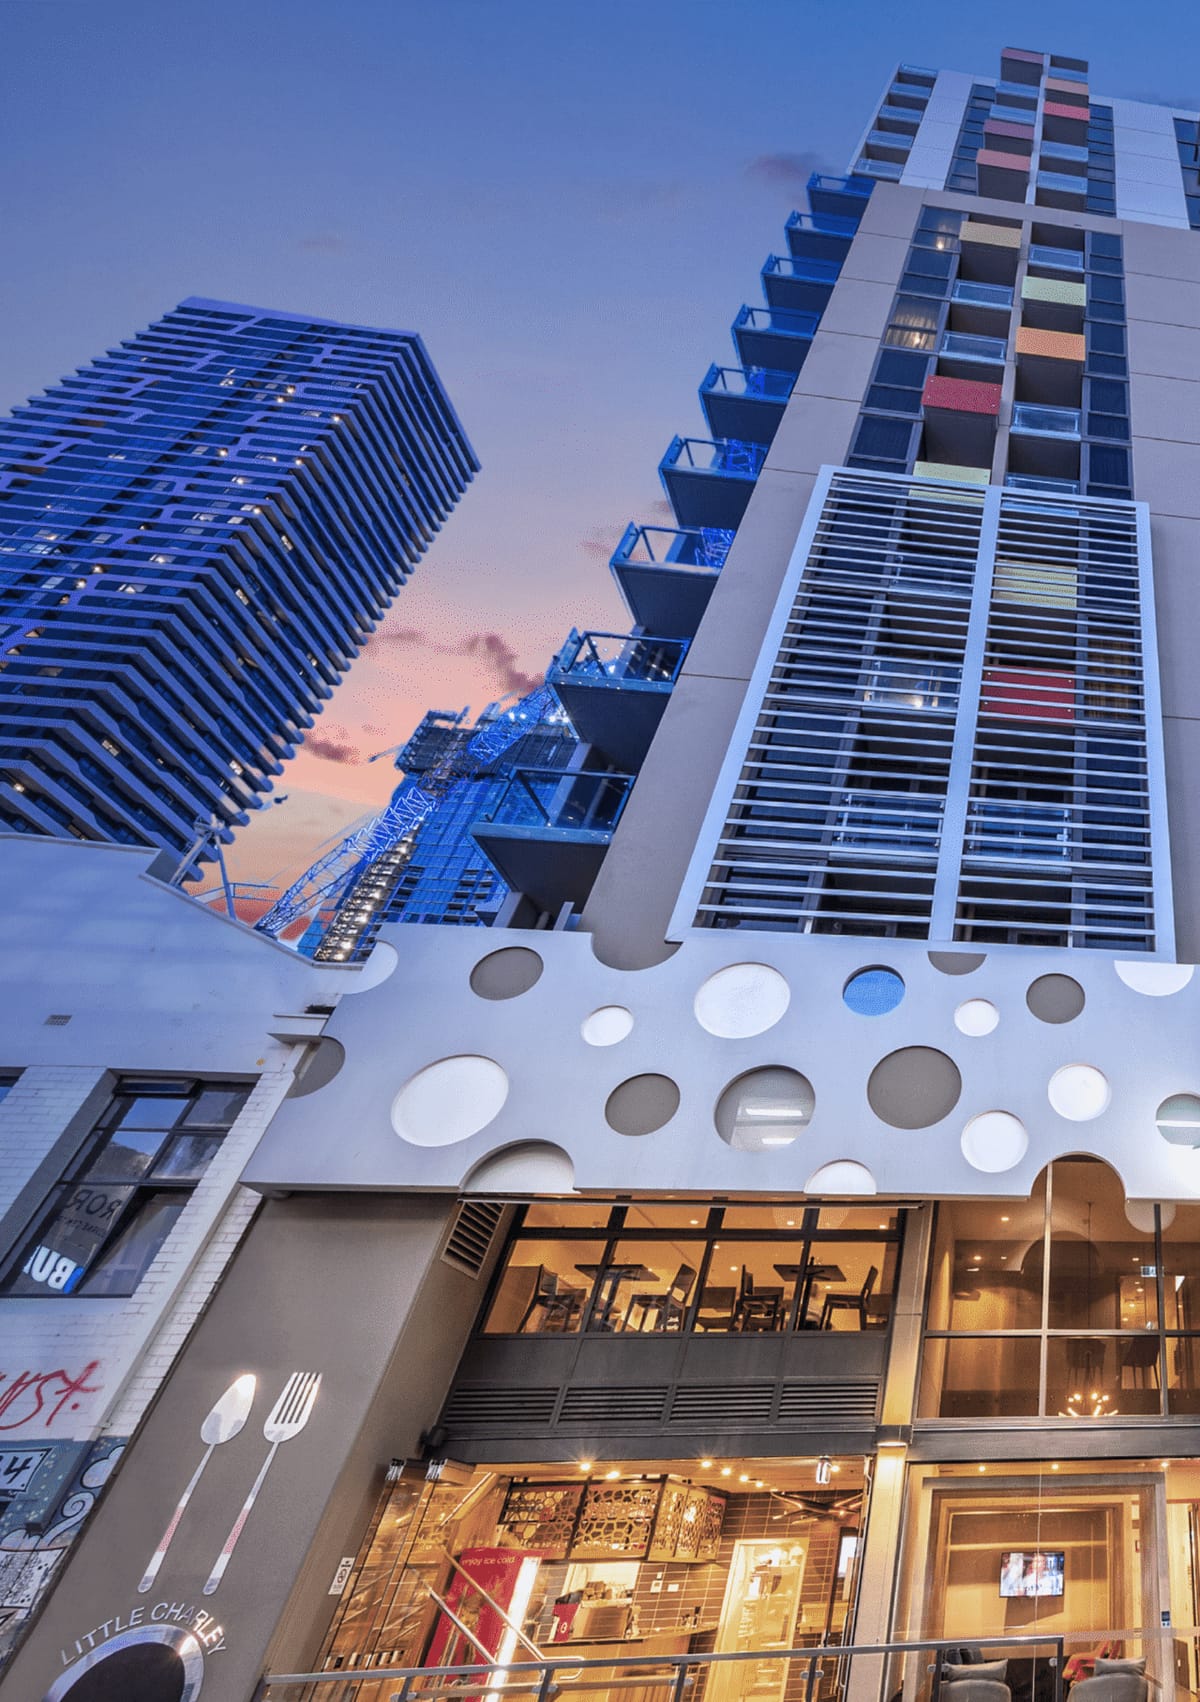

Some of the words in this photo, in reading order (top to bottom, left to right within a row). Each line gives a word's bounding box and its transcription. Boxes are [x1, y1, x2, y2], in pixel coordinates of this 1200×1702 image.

[0, 1456, 33, 1485] 4
[60, 1606, 145, 1666] LITTLE
[151, 1602, 227, 1656] CHARLEY
